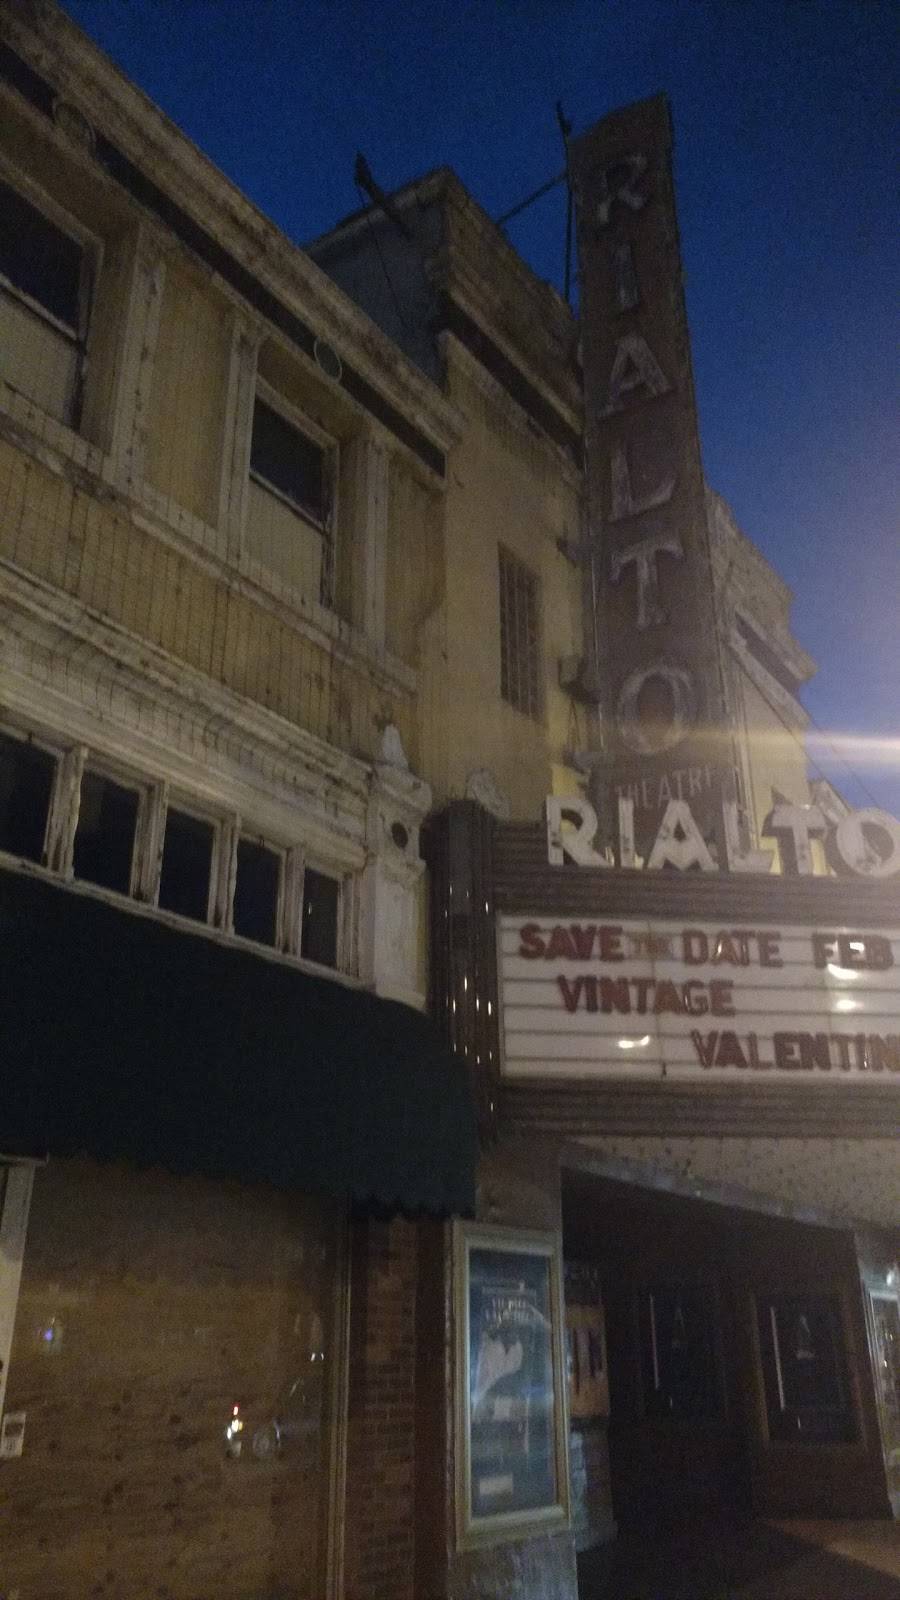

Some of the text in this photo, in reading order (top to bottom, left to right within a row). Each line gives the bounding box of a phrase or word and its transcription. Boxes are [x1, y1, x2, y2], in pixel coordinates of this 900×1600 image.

[597, 152, 690, 757] RIALTO
[545, 793, 900, 878] RIALTO
[519, 923, 625, 962] SAVE
[681, 929, 783, 968] DATE
[811, 931, 894, 970] FEB
[557, 975, 736, 1016] VINTAGE
[689, 1028, 900, 1071] VALENTIN
